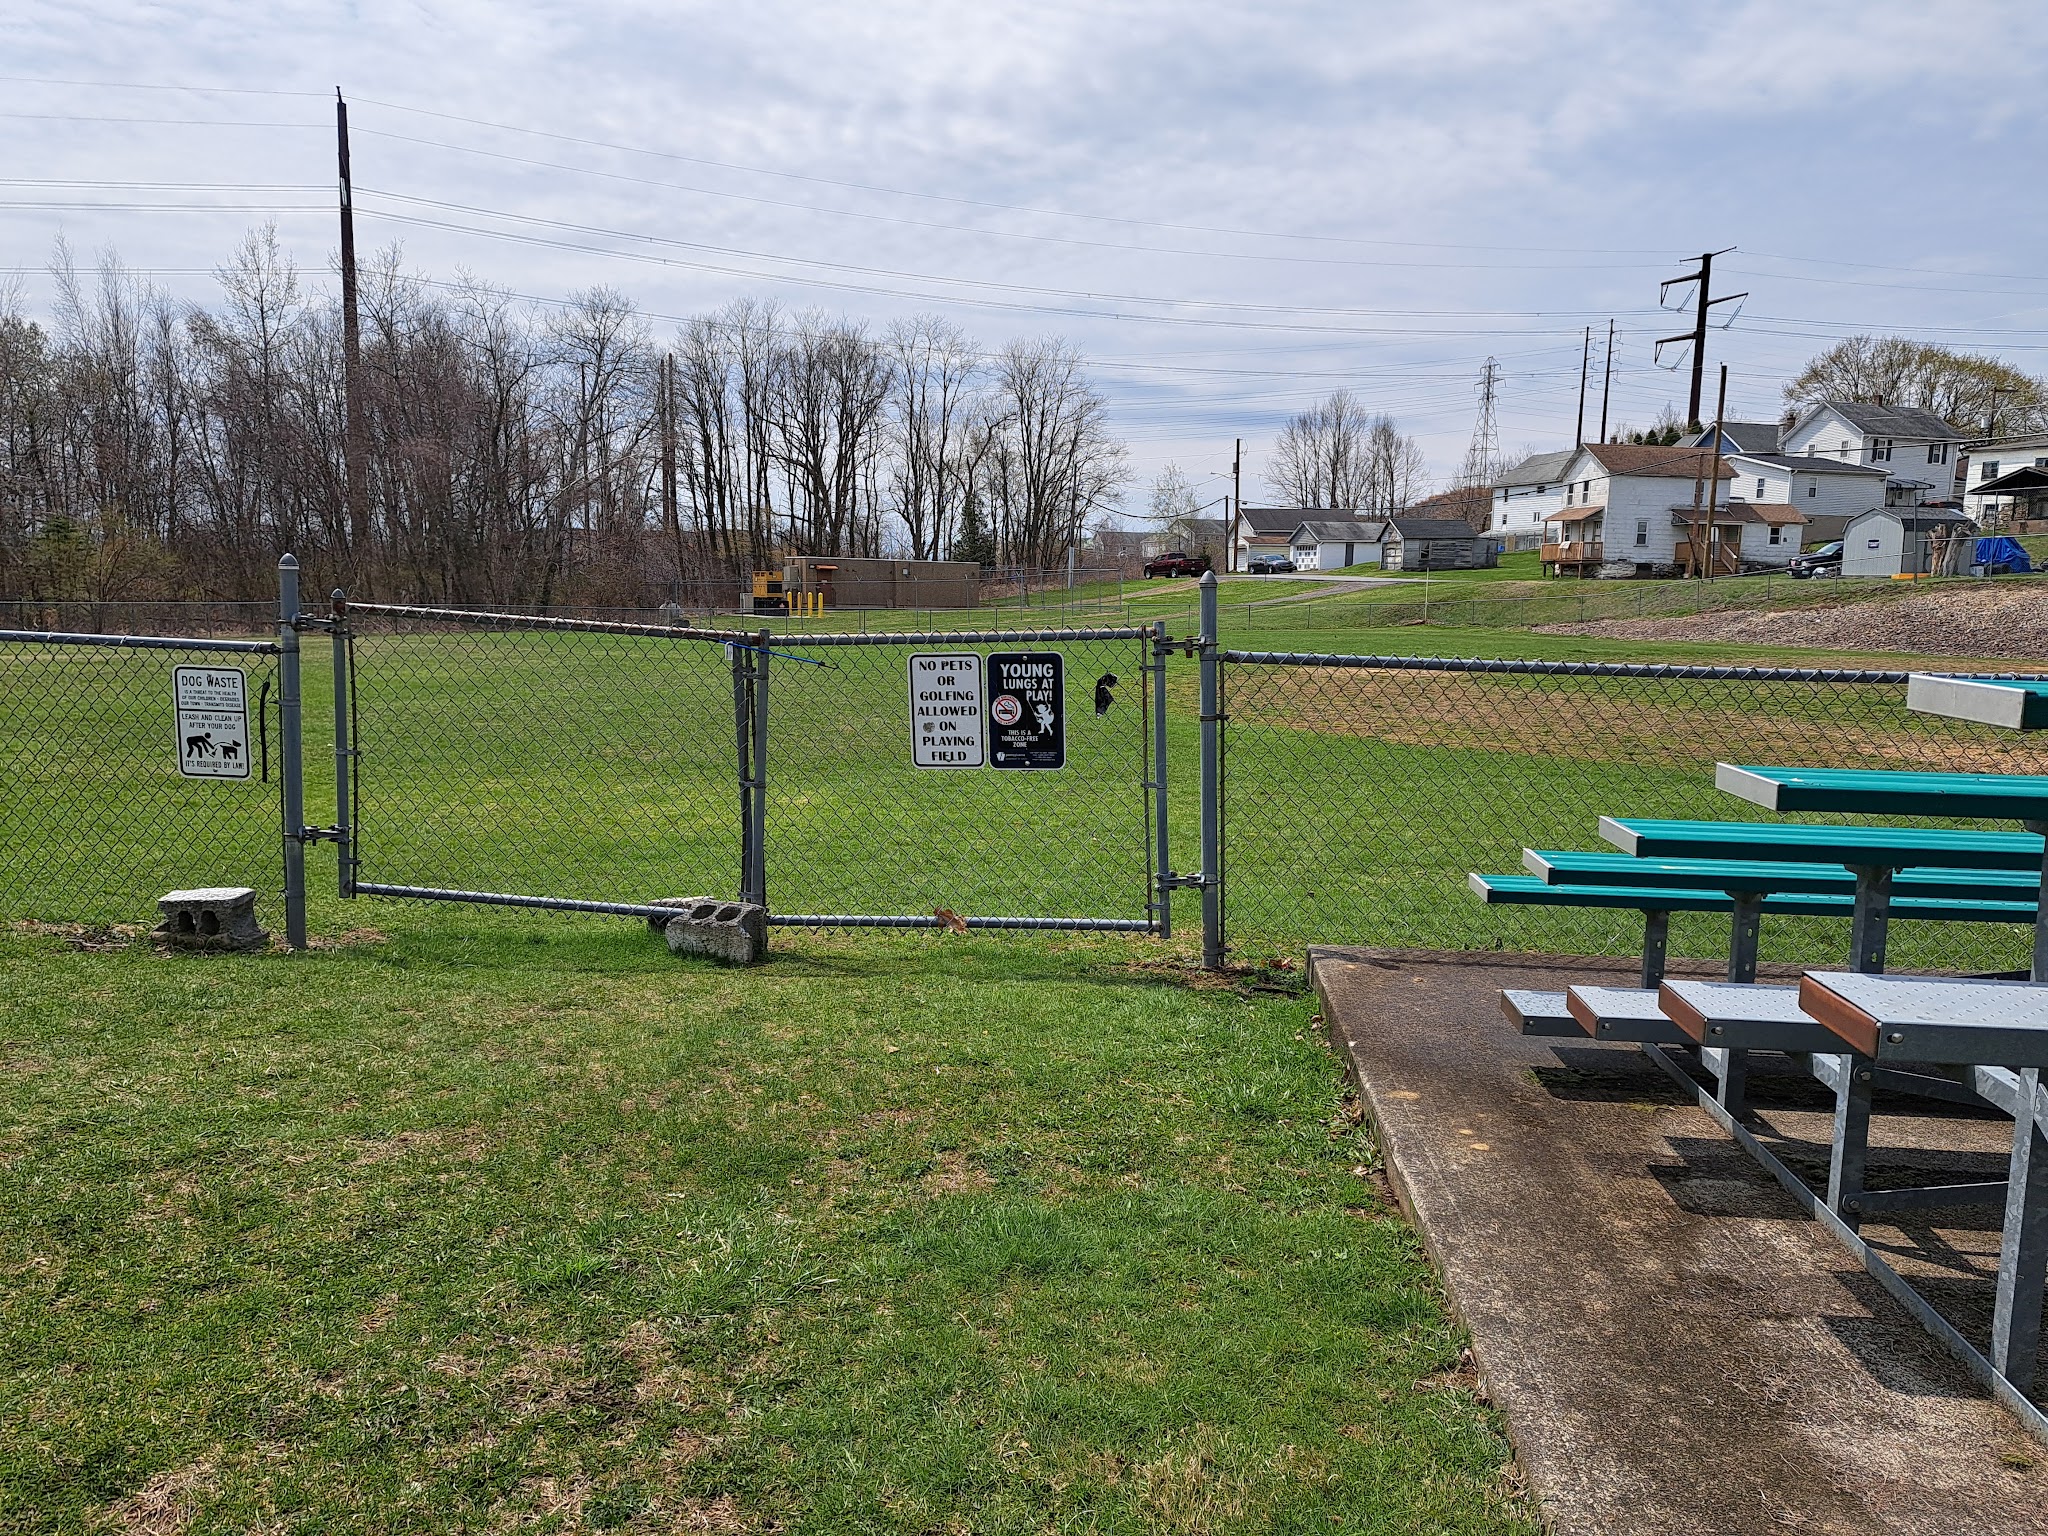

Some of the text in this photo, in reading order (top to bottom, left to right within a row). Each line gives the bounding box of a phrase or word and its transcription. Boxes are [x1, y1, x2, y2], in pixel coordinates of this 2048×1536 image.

[919, 660, 972, 671] NO PETS
[1000, 663, 1054, 678] YOUNG
[182, 676, 238, 688] DOG WASTE
[937, 676, 955, 686] OR
[1003, 679, 1054, 689] LUNGS AT
[920, 690, 974, 701] GOLFING
[1026, 690, 1053, 701] PLAY!
[917, 706, 977, 716] ALLOWED
[939, 721, 956, 731] ON
[922, 736, 975, 746] PLAYING
[931, 751, 967, 761] FIELD
[232, 762, 244, 770] LAW!
